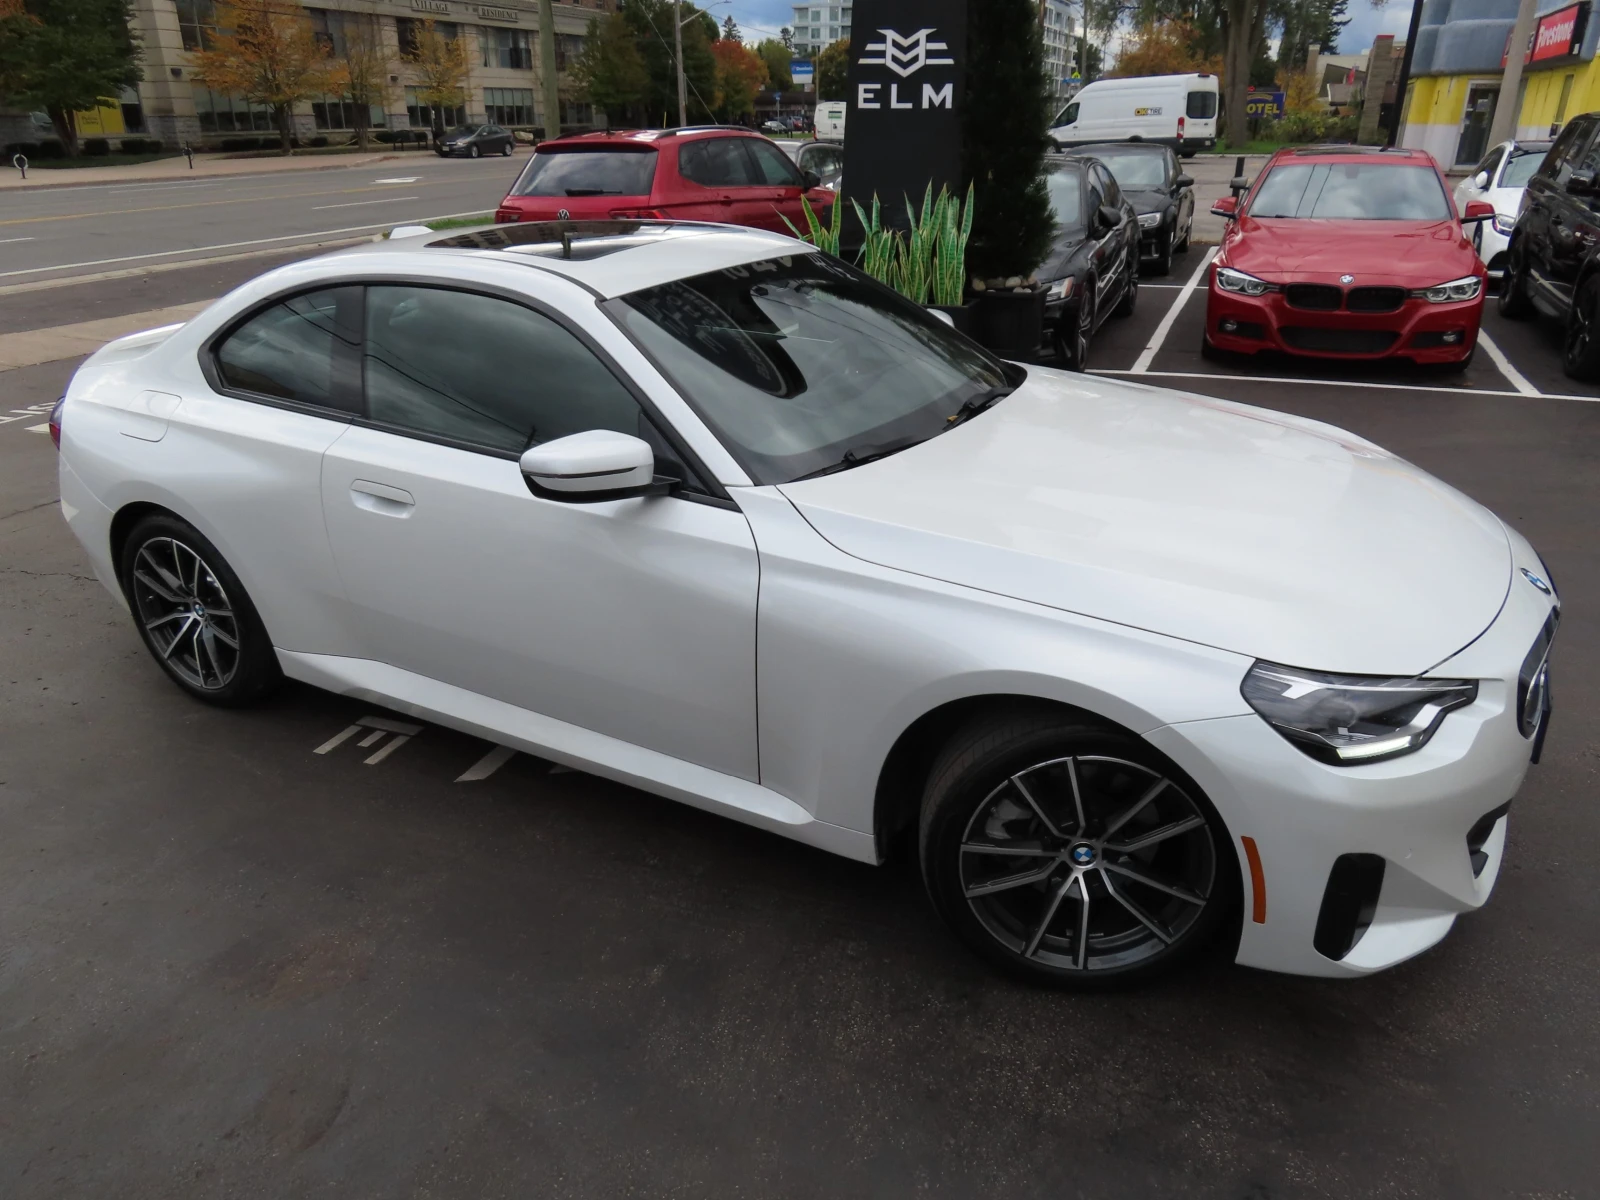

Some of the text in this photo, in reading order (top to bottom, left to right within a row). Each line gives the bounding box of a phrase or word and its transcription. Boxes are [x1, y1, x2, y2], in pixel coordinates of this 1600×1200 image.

[415, 0, 518, 19] VILLAGE RESIDENCE
[1536, 20, 1574, 53] Firestone
[858, 83, 953, 109] ELM
[1246, 103, 1280, 114] OTEL
